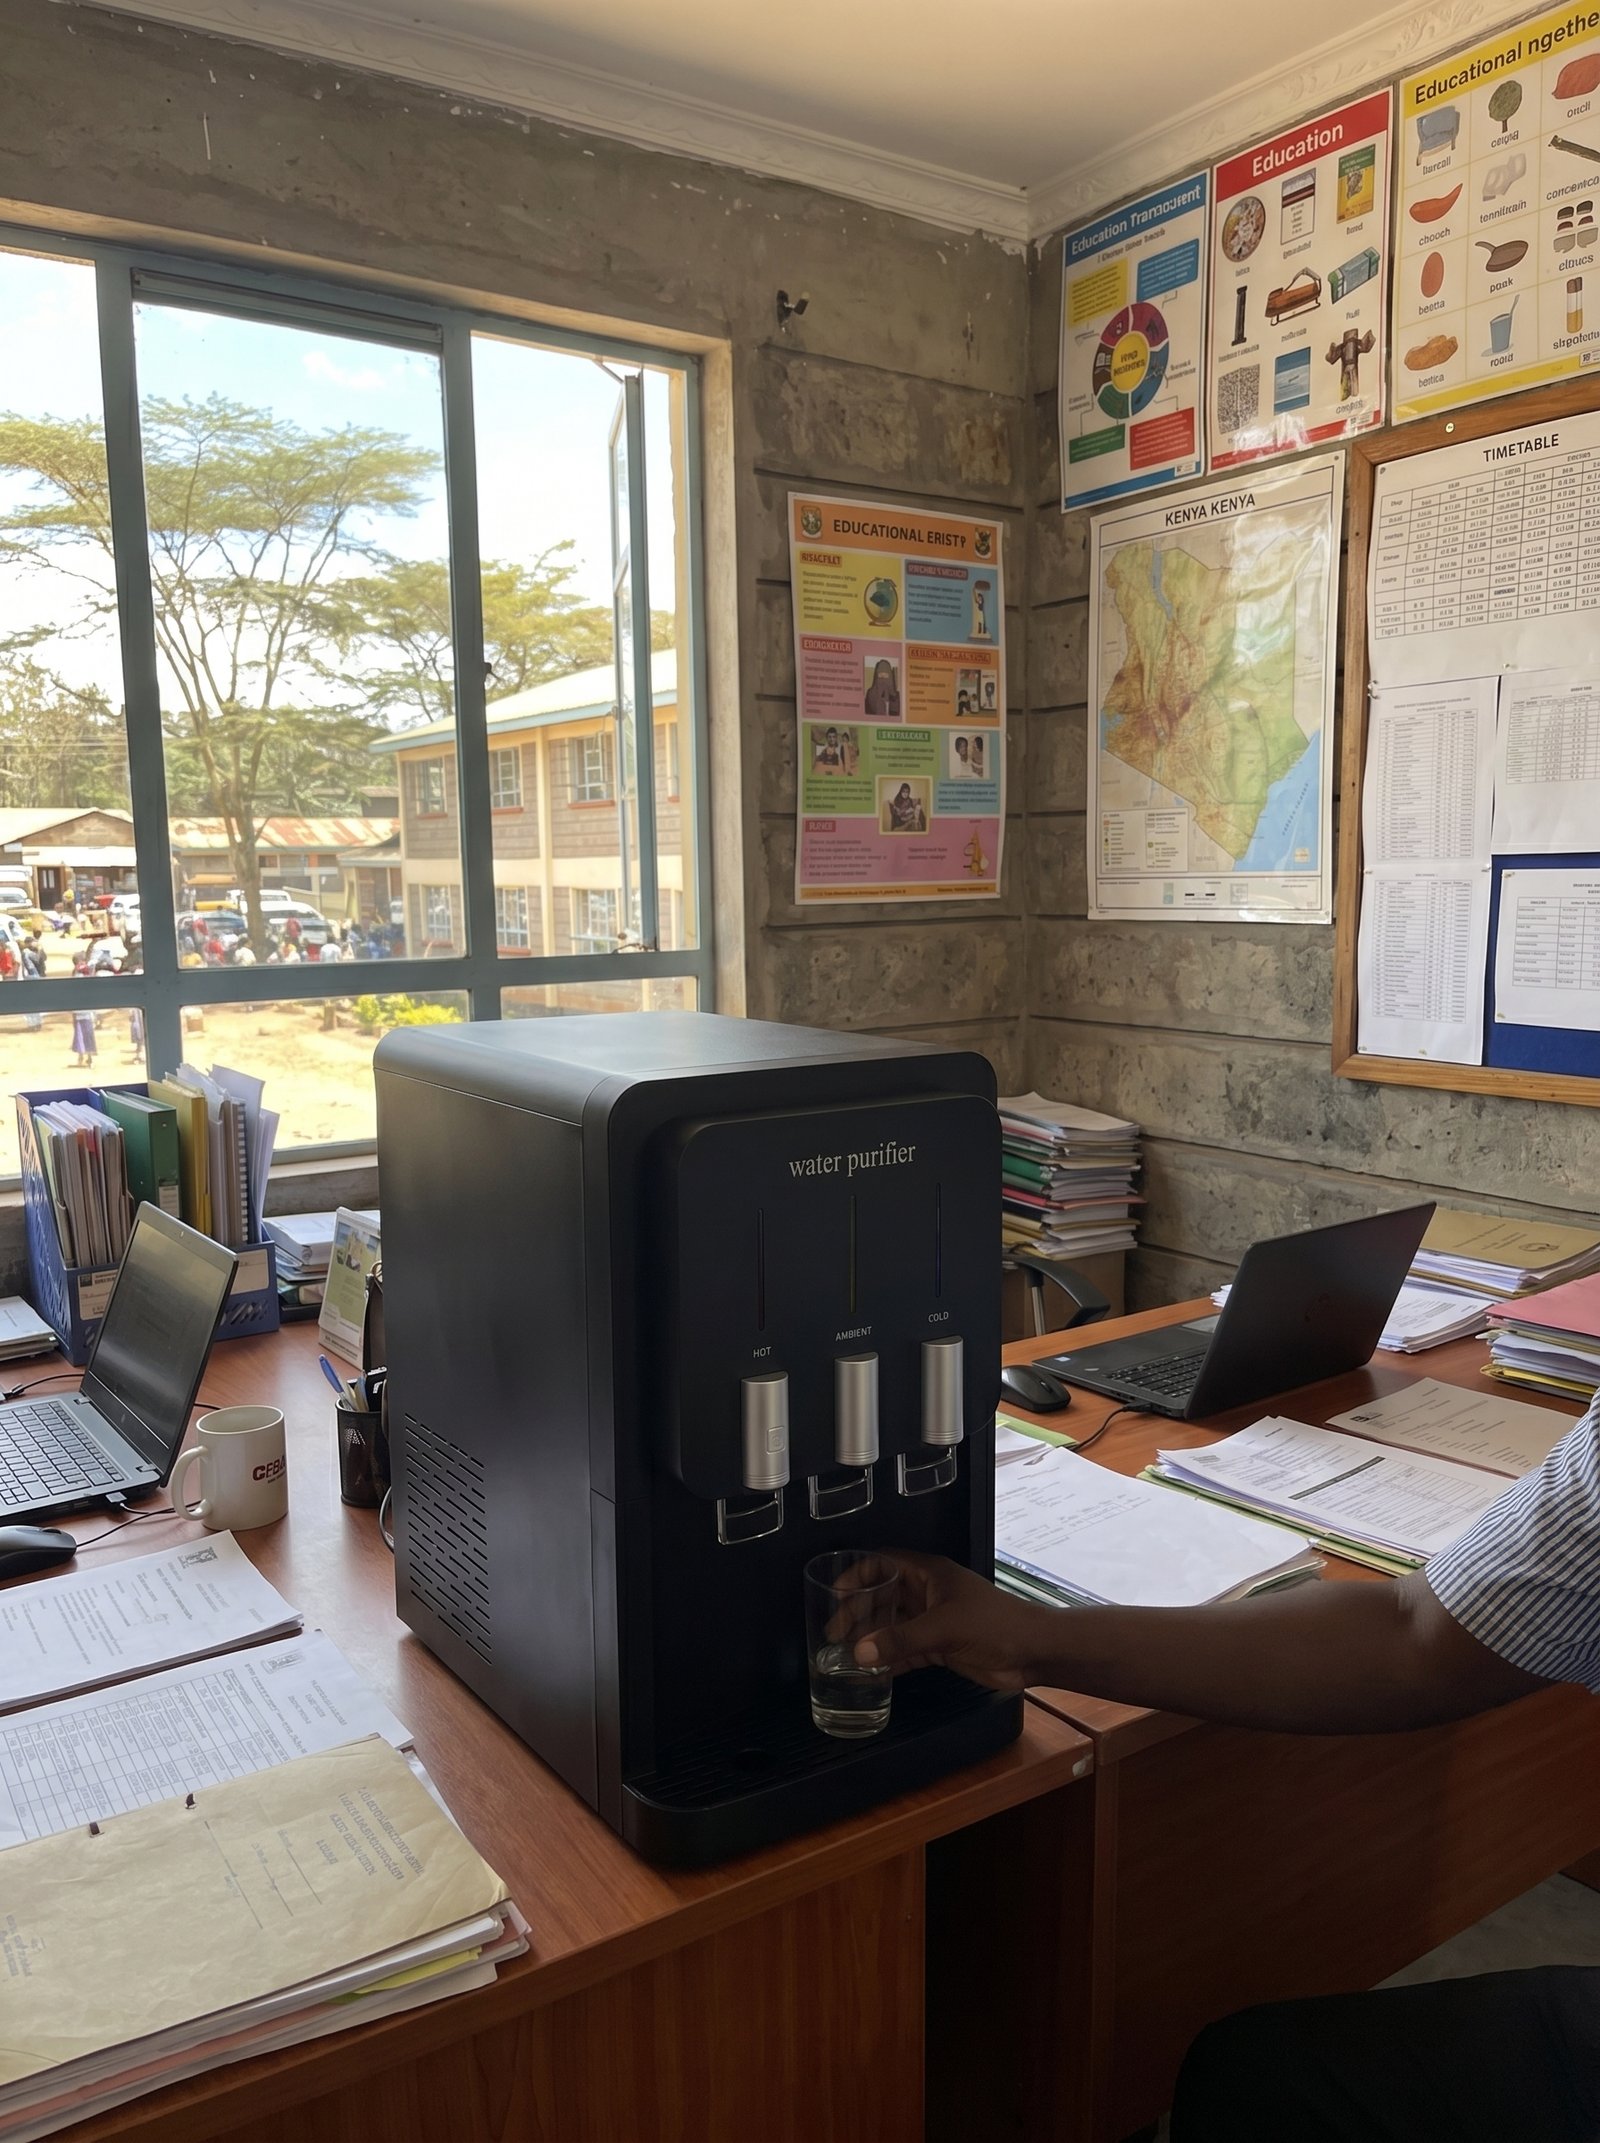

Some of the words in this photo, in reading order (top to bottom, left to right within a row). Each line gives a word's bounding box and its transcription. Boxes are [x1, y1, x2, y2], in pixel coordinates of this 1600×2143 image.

[1415, 41, 1522, 104] Educational
[1252, 123, 1344, 177] Education
[1071, 220, 1128, 255] Education
[1482, 433, 1559, 462] TIMETABLE
[1165, 505, 1207, 527] KENYA
[1211, 493, 1255, 516] KENYA
[833, 519, 924, 542] EDUCATIONAL
[789, 1154, 842, 1178] water
[847, 1141, 916, 1177] purifier
[928, 1311, 949, 1323] COLD
[835, 1326, 872, 1341] AMBIENT
[753, 1346, 771, 1358] HOT
